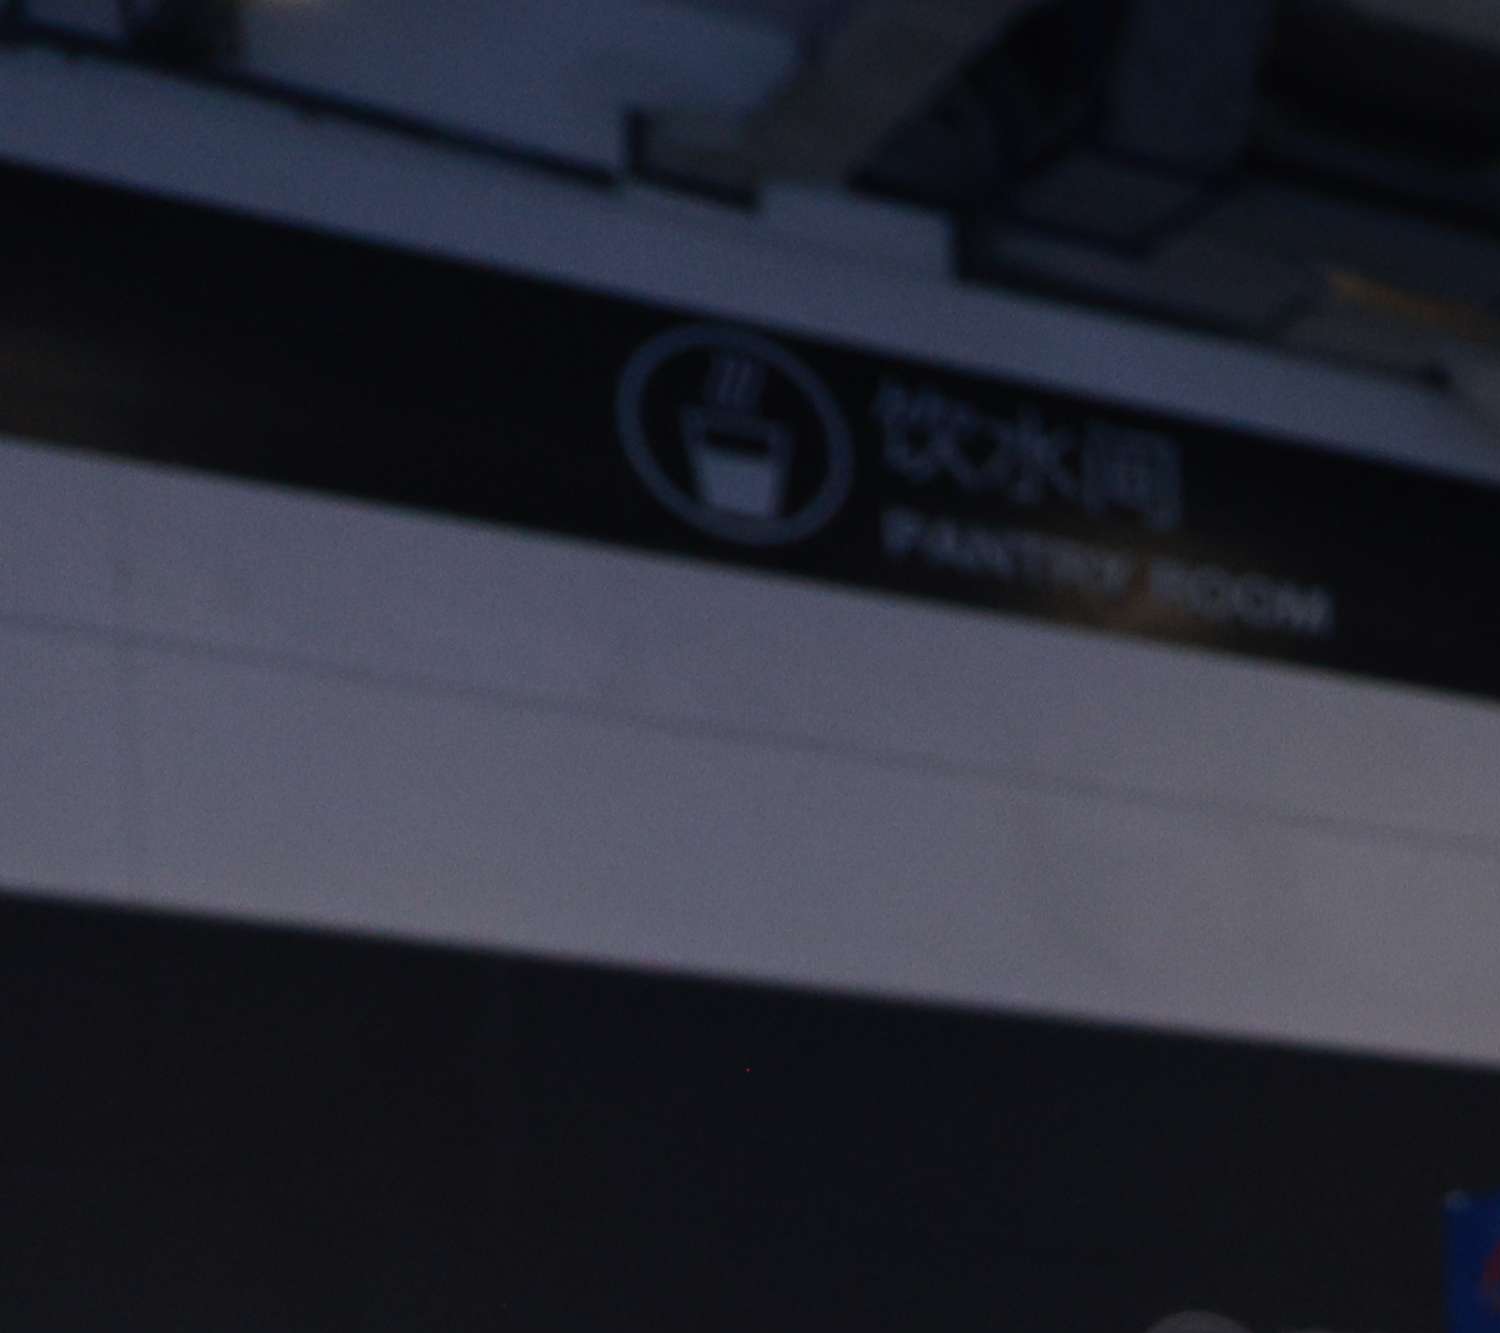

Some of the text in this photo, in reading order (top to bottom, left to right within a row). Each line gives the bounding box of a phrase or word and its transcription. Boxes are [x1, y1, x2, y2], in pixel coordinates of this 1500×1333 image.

[872, 378, 1186, 534] 饮水间
[878, 508, 1336, 638] PANTRY ROOM
